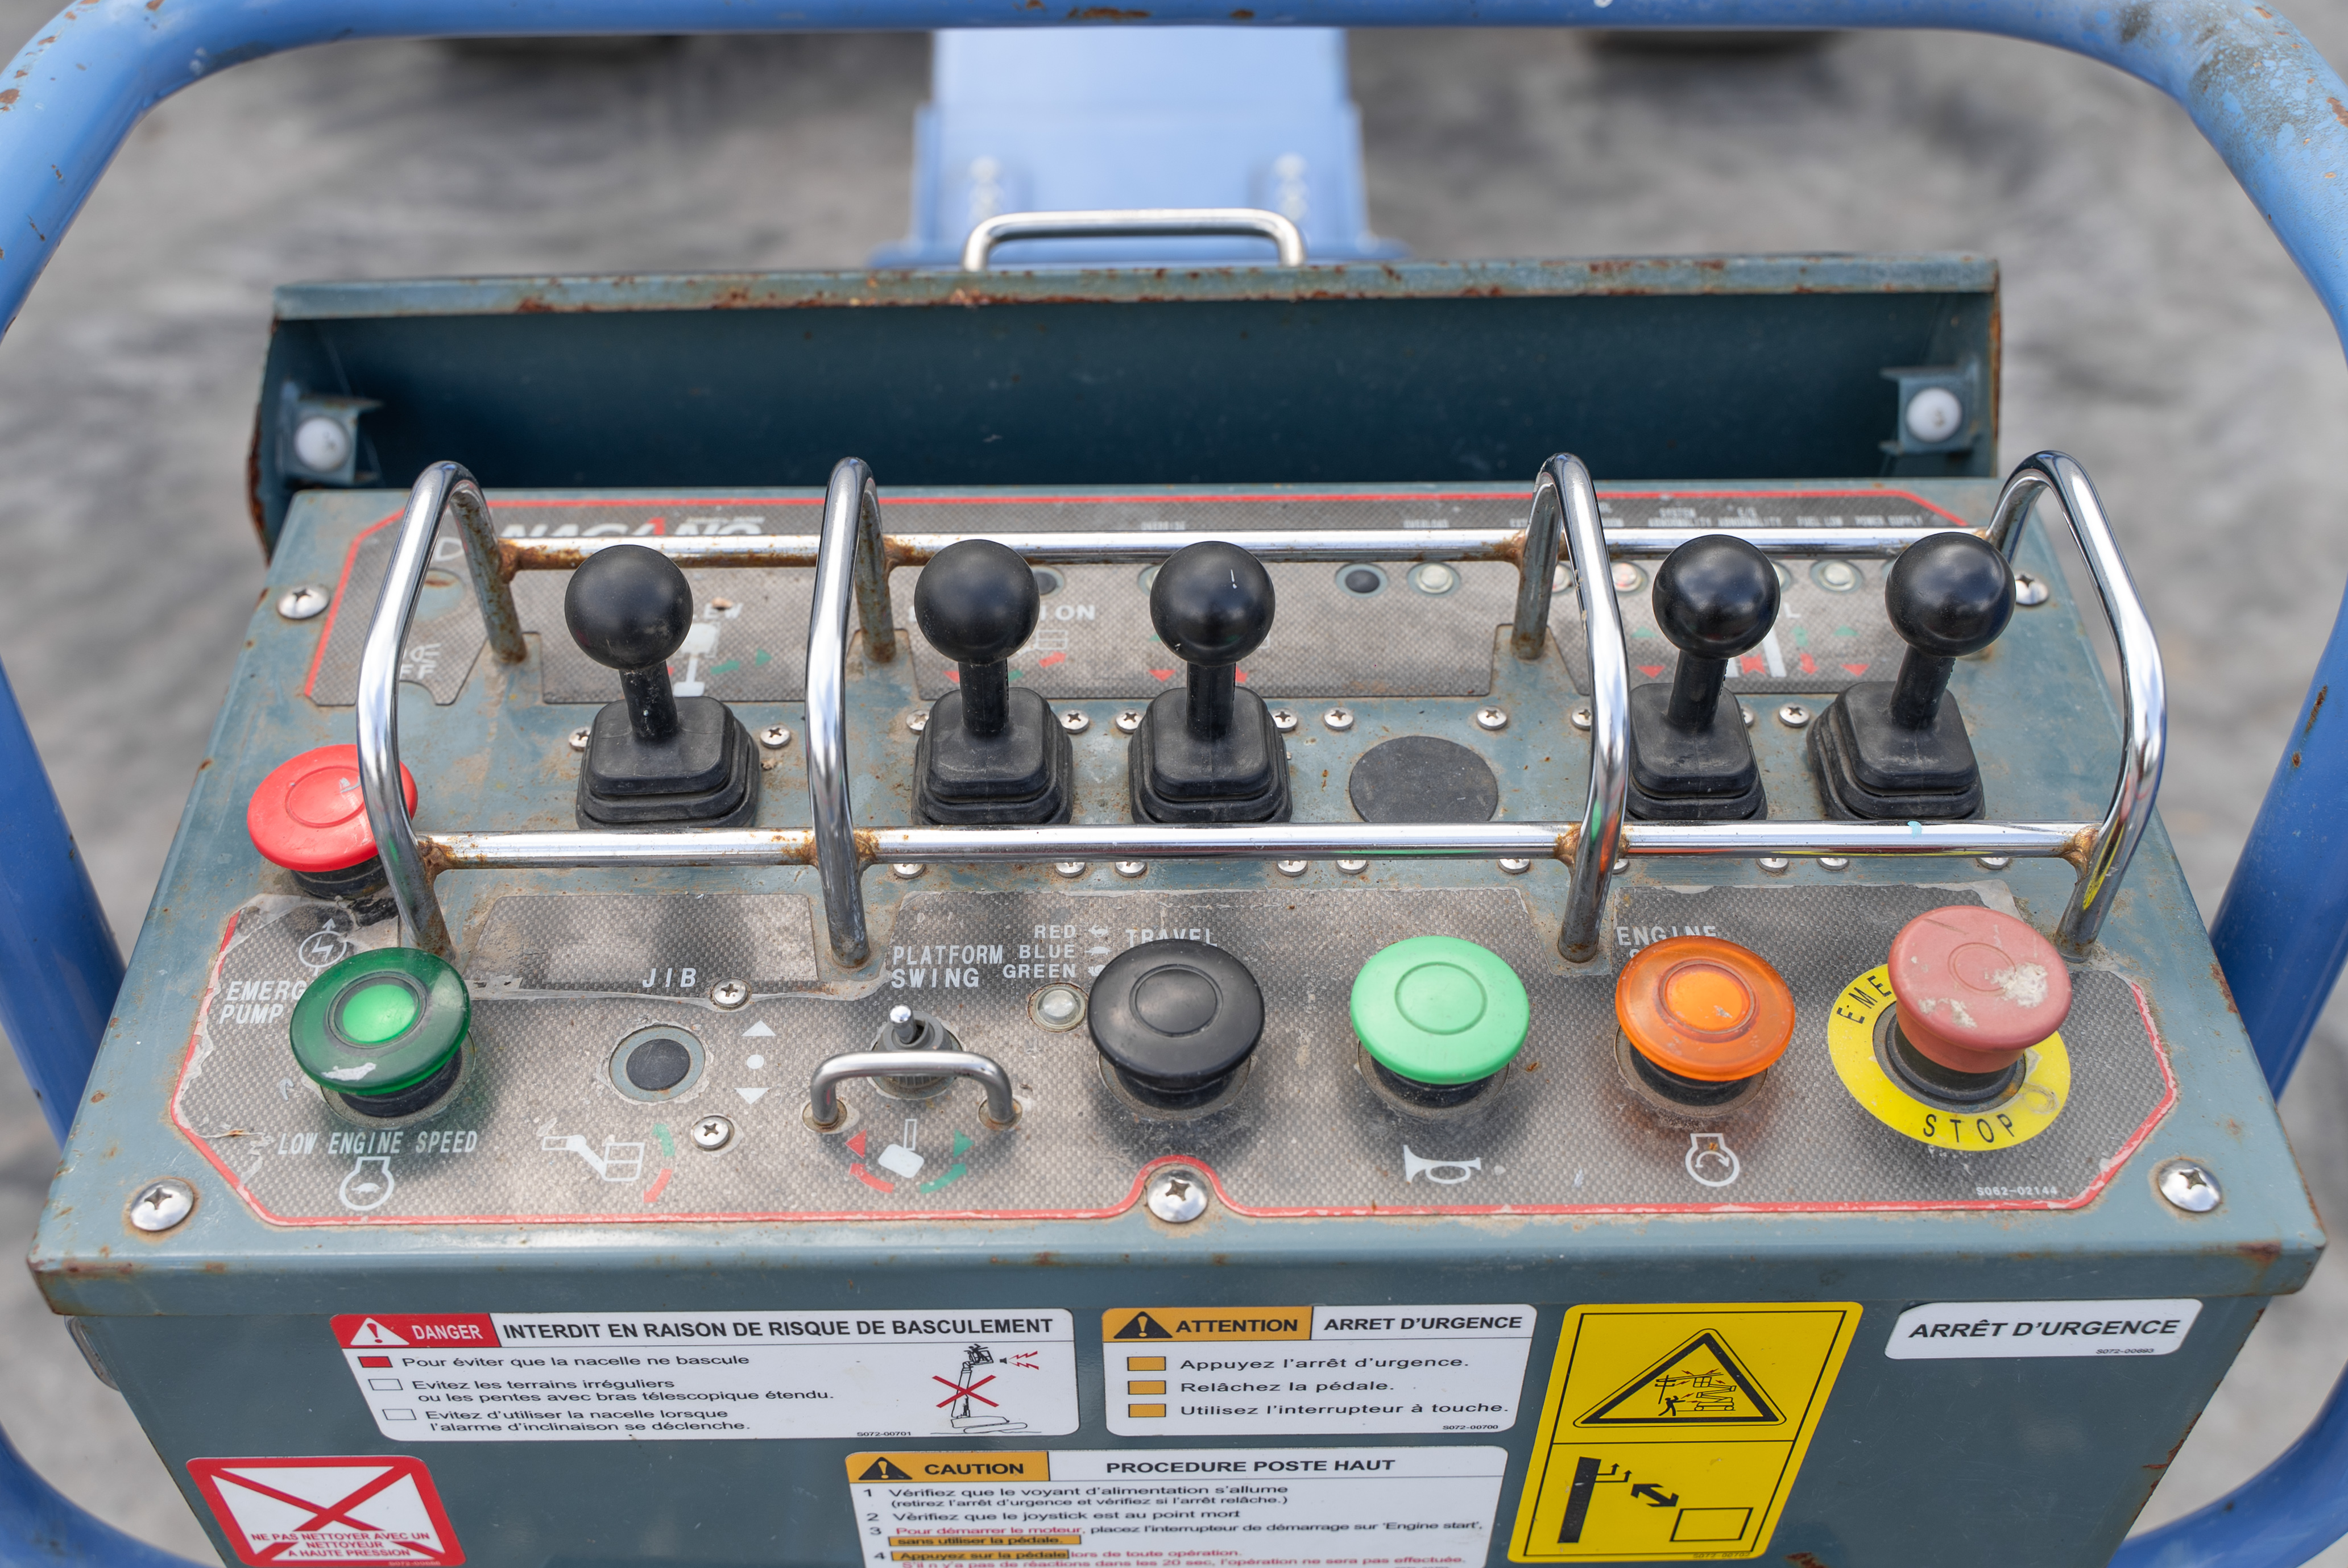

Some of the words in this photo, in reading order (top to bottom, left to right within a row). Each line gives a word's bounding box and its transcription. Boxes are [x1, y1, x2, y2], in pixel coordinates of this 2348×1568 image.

[1034, 924, 1076, 939] RED
[893, 944, 1003, 965] PLATFORM
[1019, 944, 1075, 959] BLUE
[1003, 964, 1076, 978] GREEN
[642, 968, 697, 988] JIB
[891, 969, 979, 988] SWING
[220, 1004, 284, 1024] PUMP
[1923, 1113, 2016, 1143] STOP
[278, 1133, 318, 1155] LOW
[328, 1131, 402, 1154] ENGINE
[416, 1130, 478, 1153] SPEED
[503, 1324, 601, 1339] INTERDIT
[607, 1324, 639, 1338] EN
[643, 1322, 727, 1337] RAISON
[732, 1322, 763, 1337] DE
[768, 1321, 851, 1337] RISQUE
[856, 1321, 886, 1335] DE
[892, 1319, 1053, 1334] BASCULEMENT
[1175, 1320, 1298, 1333] ATTENTION
[1323, 1318, 1395, 1330] ARRET
[1400, 1317, 1523, 1330] D'URGENCE
[1908, 1320, 2009, 1338] ARRÊT
[2012, 1320, 2181, 1337] D'URGENCE
[411, 1325, 483, 1339] DANGER
[401, 1358, 447, 1367] Pour
[453, 1358, 504, 1367] éviter
[510, 1359, 545, 1368] que
[550, 1358, 568, 1366] la
[574, 1357, 641, 1366] nacelle
[676, 1355, 749, 1365] bascule
[1180, 1360, 1274, 1371] Appuyez
[1283, 1359, 1347, 1368] l'arrêt
[1355, 1358, 1468, 1370] d'urgence.
[412, 1381, 470, 1389] Evitez
[474, 1381, 502, 1389] les
[507, 1380, 577, 1389] terrains
[582, 1380, 675, 1391] irréguliers
[1181, 1383, 1281, 1392] Relâchez
[1289, 1382, 1307, 1391] la
[1316, 1382, 1394, 1393] pédale.
[445, 1393, 474, 1402] les
[479, 1393, 541, 1404] pentes
[596, 1392, 637, 1401] bras
[641, 1392, 759, 1402] télescopique
[765, 1391, 834, 1399] étendu.
[660, 1411, 728, 1420] lorsque
[1181, 1406, 1258, 1415] Utilisez
[1267, 1405, 1404, 1416] l'interrupteur
[1411, 1404, 1423, 1413] à
[1432, 1404, 1508, 1413] touche.
[652, 1422, 751, 1432] déclenche.
[924, 1463, 1024, 1475] CAUTION
[1107, 1462, 1247, 1473] PROCEDURE
[1254, 1461, 1327, 1472] POSTE
[1334, 1460, 1395, 1471] HAUT
[1021, 1488, 1080, 1498] voyant
[1086, 1487, 1209, 1495] d'alimentation
[1023, 1512, 1087, 1521] joystick
[1153, 1511, 1195, 1520] point
[251, 1533, 271, 1541] NE
[272, 1533, 298, 1541] PAS
[870, 1527, 883, 1536] 3
[1091, 1526, 1141, 1534] placez
[1144, 1525, 1239, 1534] l'interrupteur
[938, 1537, 986, 1546] utiliser
[300, 1549, 341, 1557] HAUTE
